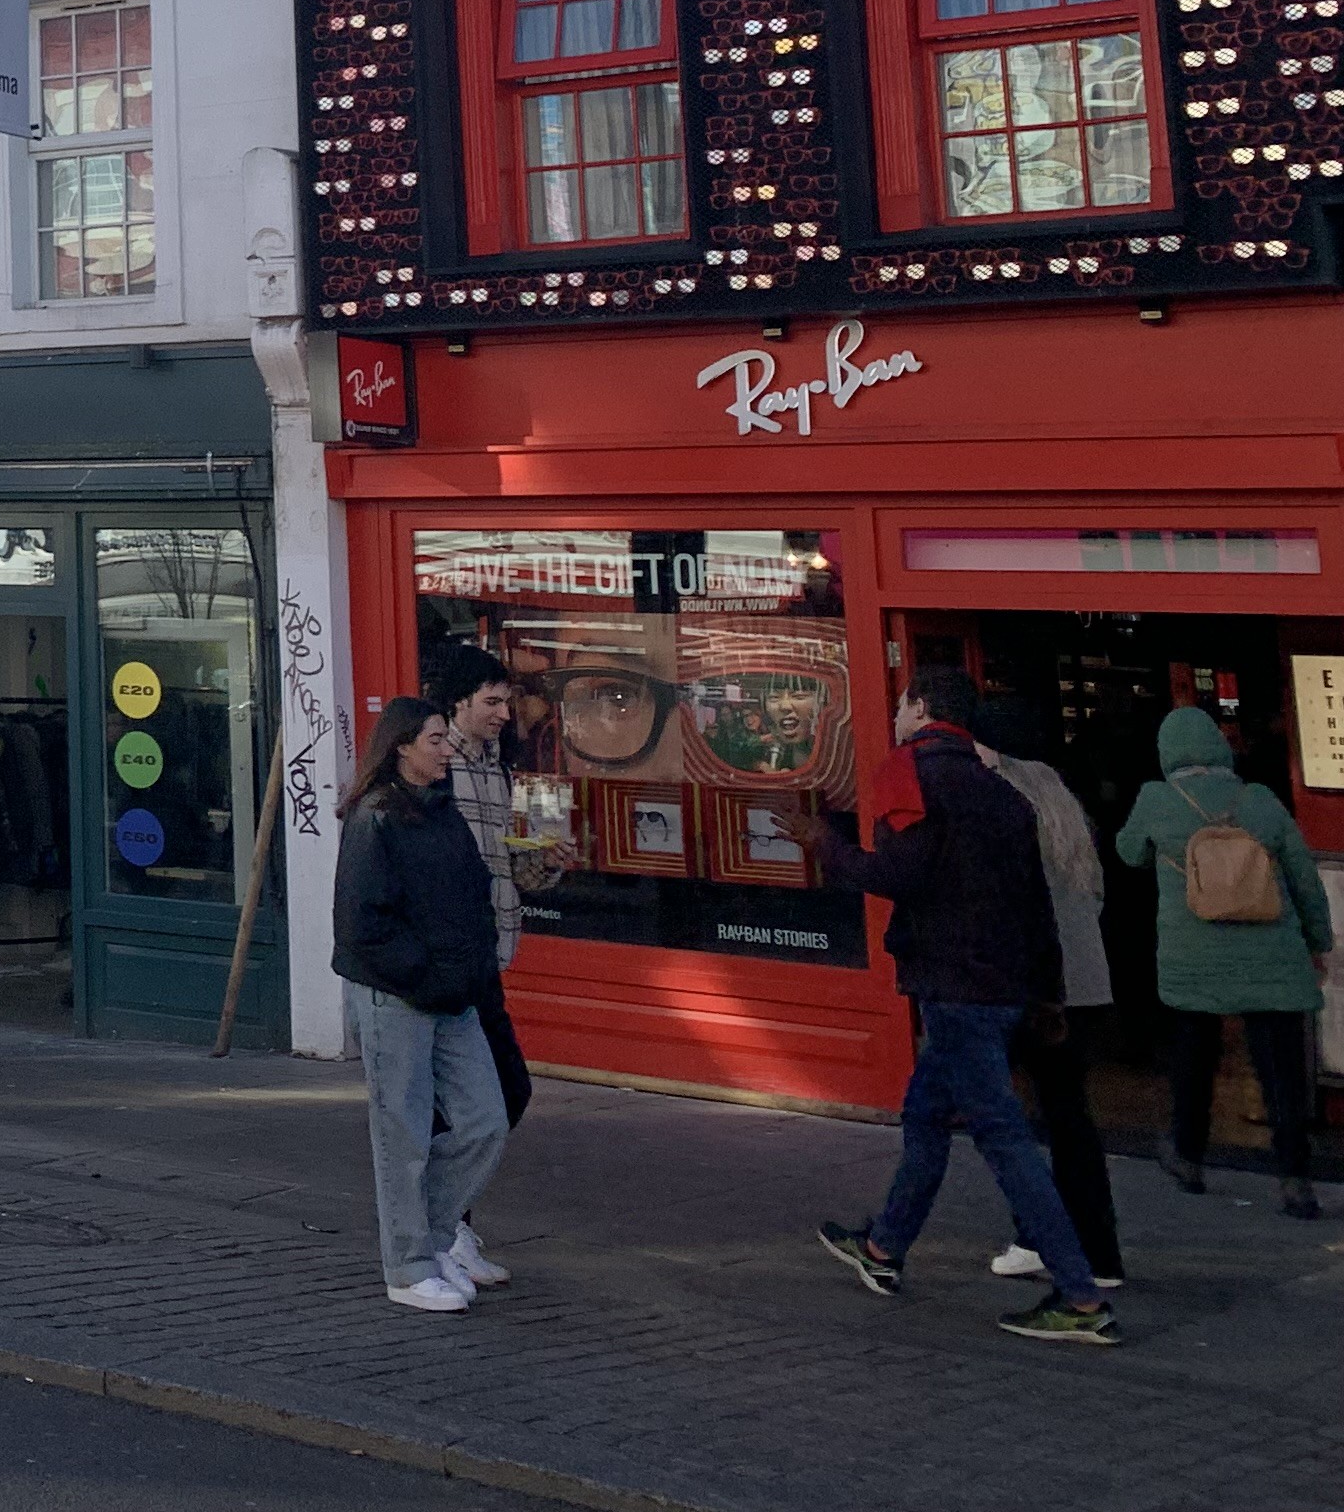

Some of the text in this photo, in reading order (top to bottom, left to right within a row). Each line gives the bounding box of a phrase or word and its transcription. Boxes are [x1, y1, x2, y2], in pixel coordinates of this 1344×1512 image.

[532, 553, 590, 595] THE
[595, 553, 664, 595] GIFT
[1322, 669, 1334, 689] E
[119, 684, 154, 696] £20
[121, 754, 156, 766] £40
[532, 907, 562, 920] Meta
[774, 928, 828, 951] STORIES
